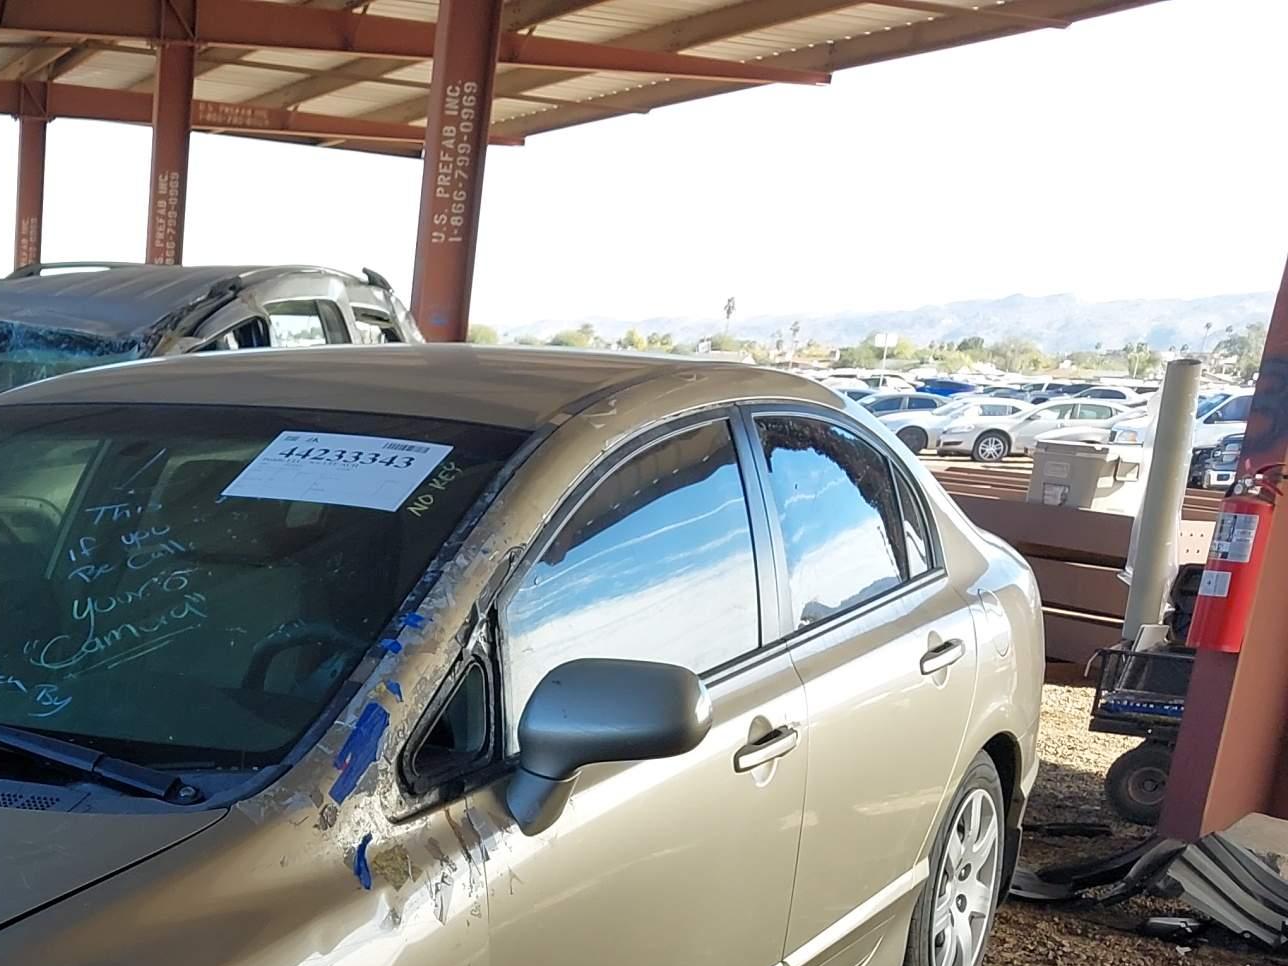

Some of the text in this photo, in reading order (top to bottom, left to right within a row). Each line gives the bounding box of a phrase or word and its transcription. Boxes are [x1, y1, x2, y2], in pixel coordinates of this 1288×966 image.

[445, 79, 463, 115] INC.
[436, 125, 457, 198] PREFAB
[448, 80, 479, 242] 1-866-799-0969
[278, 446, 416, 469] 44233343
[407, 461, 464, 517] NO KEY
